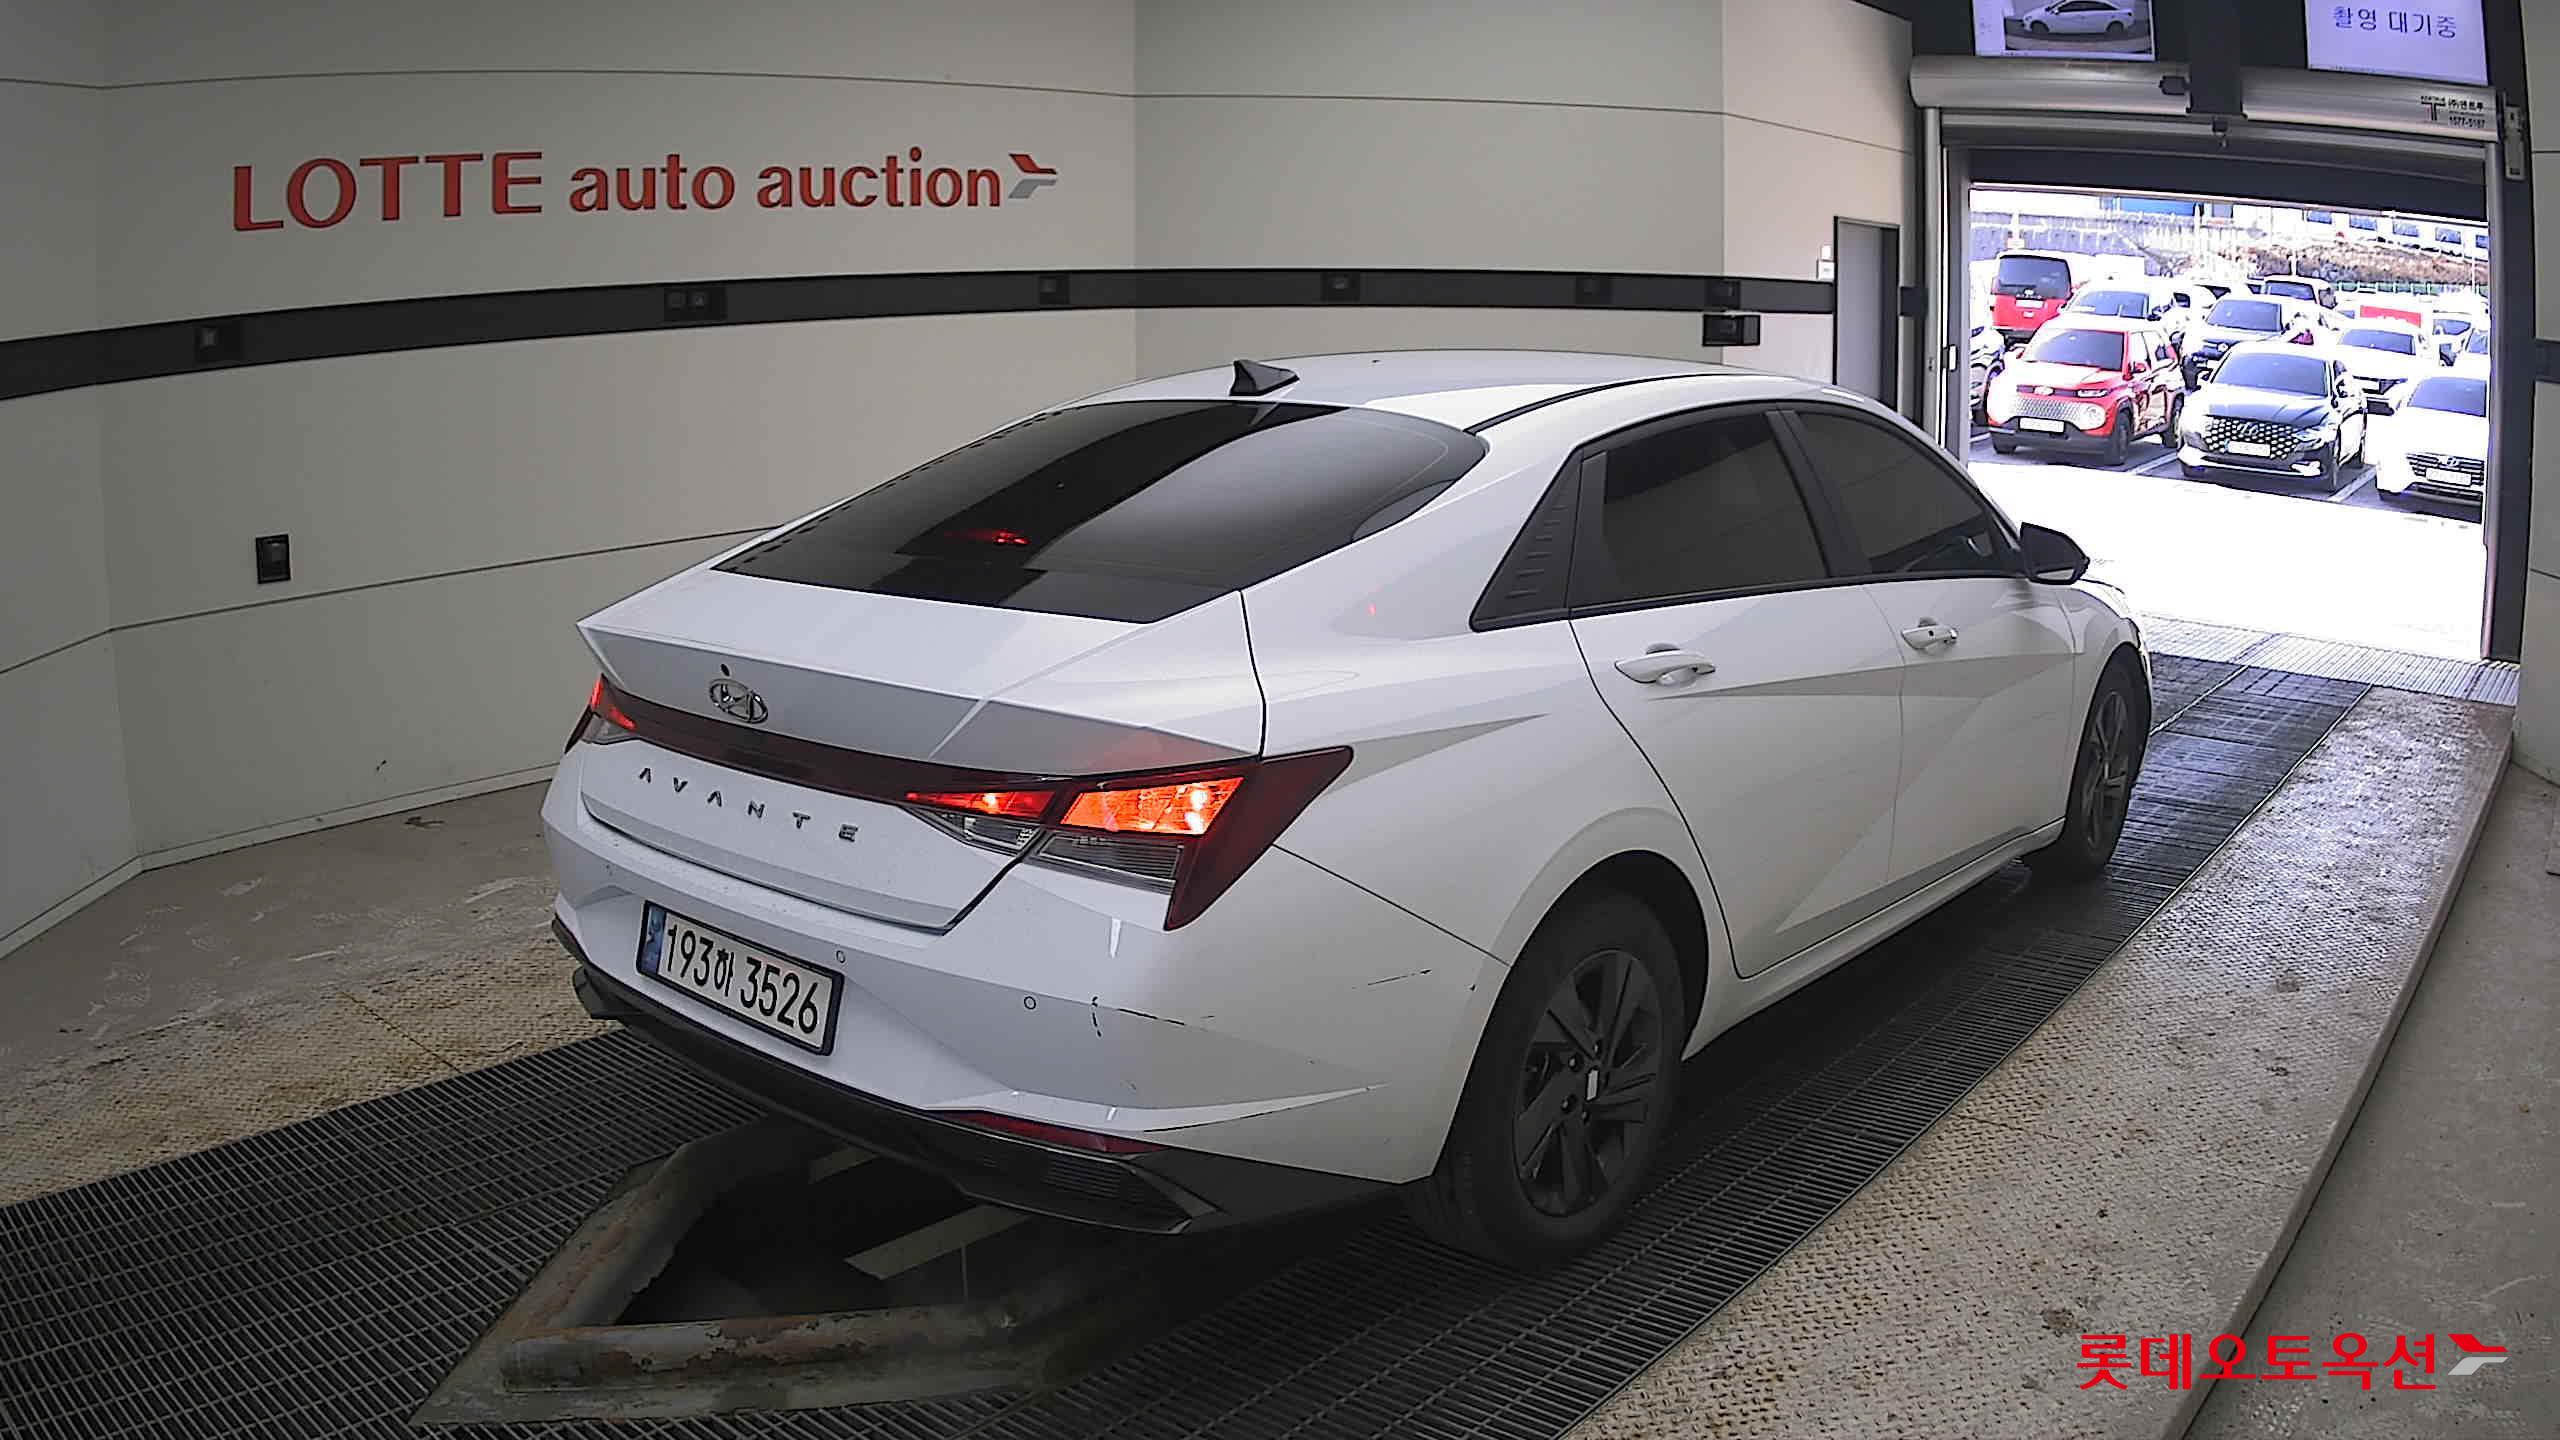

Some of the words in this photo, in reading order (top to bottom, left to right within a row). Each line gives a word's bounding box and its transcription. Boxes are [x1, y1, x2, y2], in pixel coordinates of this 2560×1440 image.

[235, 151, 542, 231] LOTTE
[567, 153, 736, 213] auto
[756, 147, 1001, 208] auction
[638, 767, 859, 843] AVANTE
[739, 955, 819, 1034] 3526
